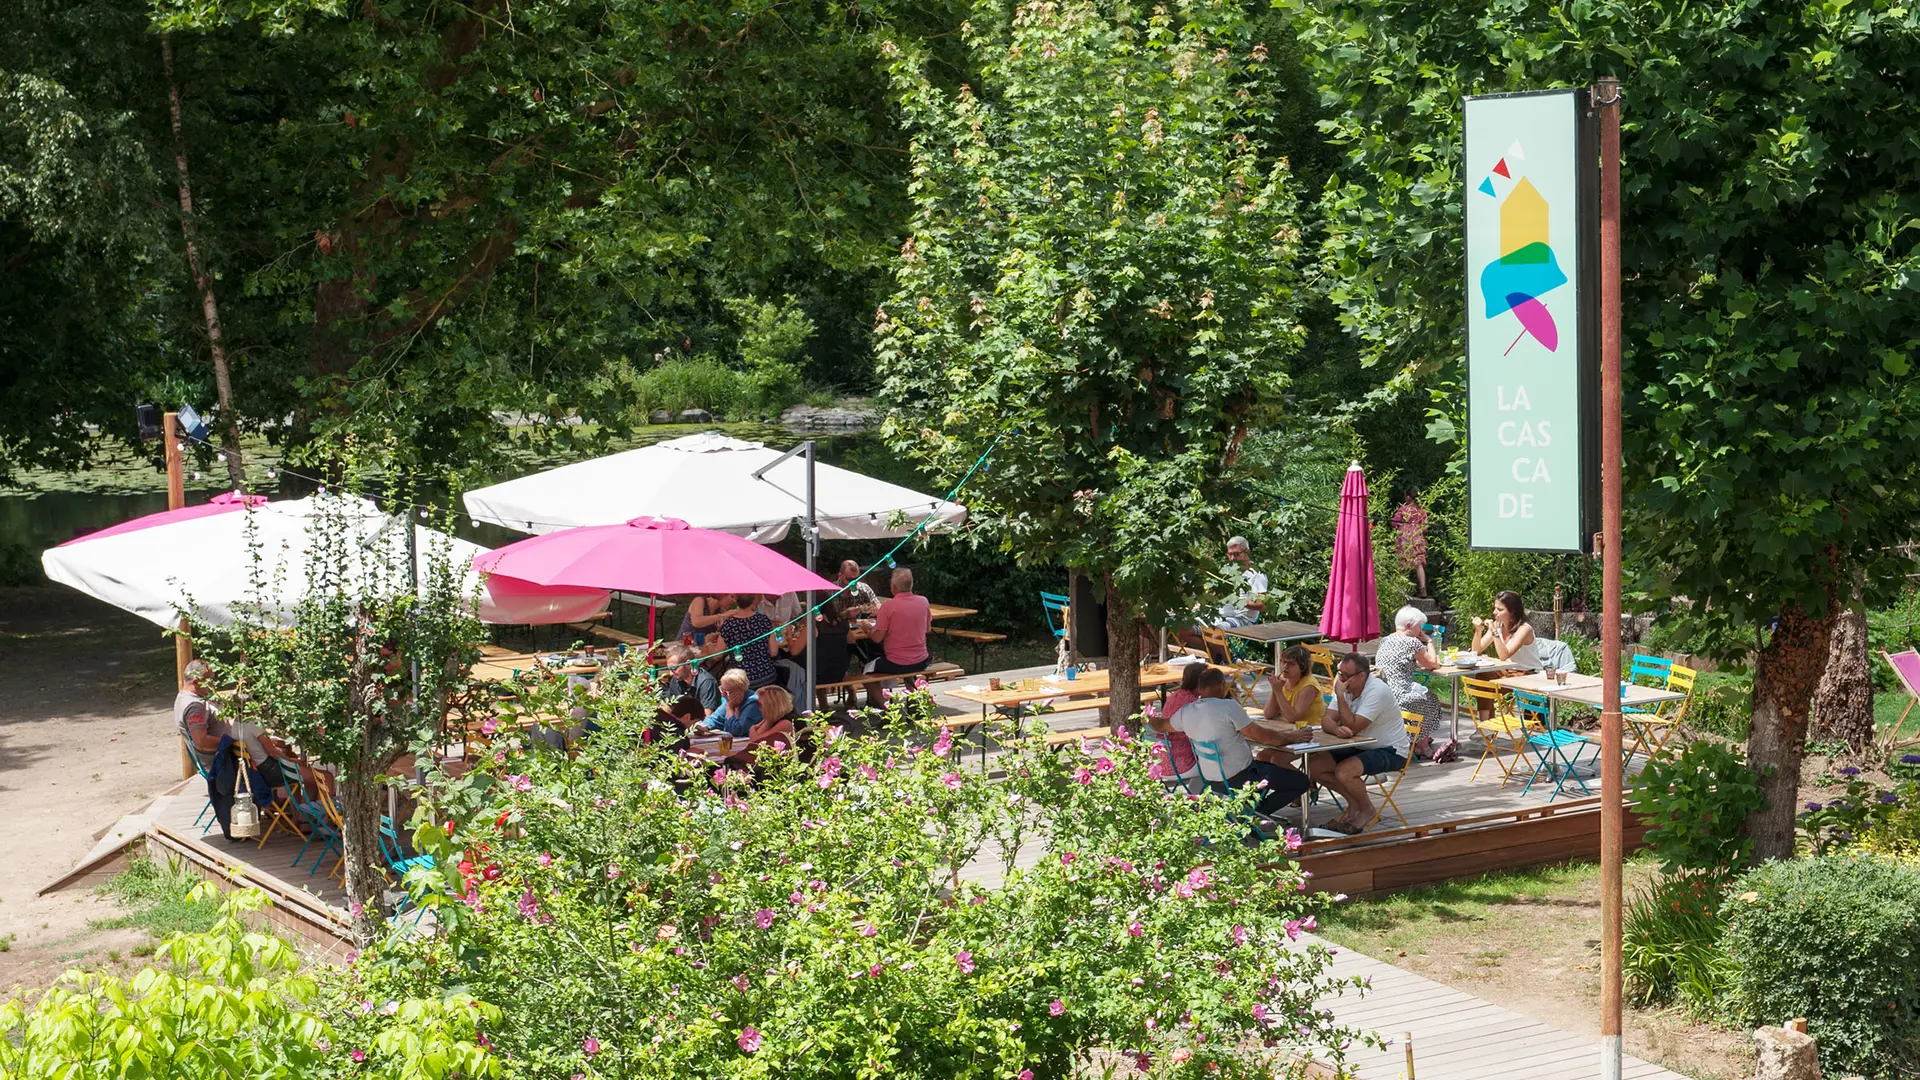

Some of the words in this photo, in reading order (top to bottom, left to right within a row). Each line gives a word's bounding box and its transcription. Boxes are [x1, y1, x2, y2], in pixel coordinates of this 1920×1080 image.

[1497, 385, 1532, 411] LA
[1497, 421, 1552, 447] CAS
[1511, 457, 1551, 483] CA
[1498, 493, 1534, 519] DE
